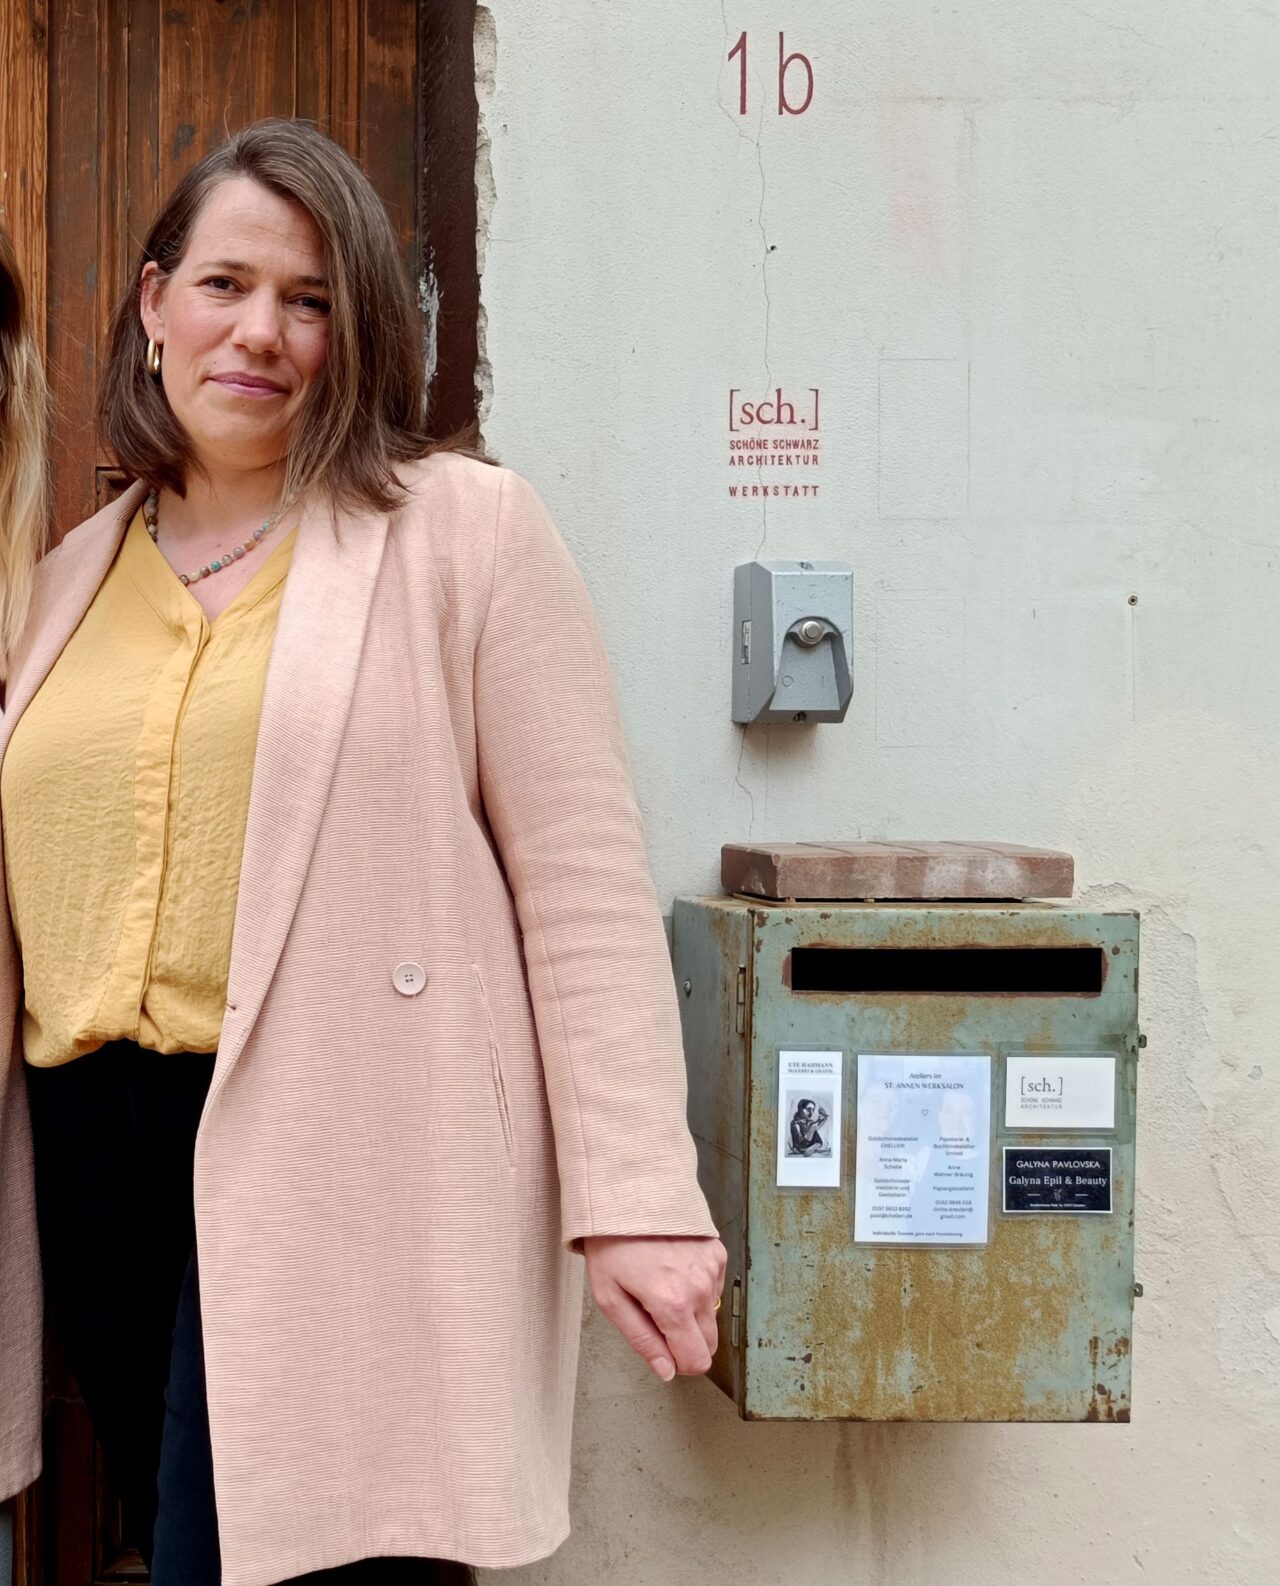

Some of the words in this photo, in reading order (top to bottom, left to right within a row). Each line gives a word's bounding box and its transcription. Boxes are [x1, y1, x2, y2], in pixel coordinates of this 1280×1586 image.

[729, 437, 769, 450] SCHÖNE
[772, 439, 820, 450] SCHWARZ
[729, 454, 819, 466] ARCHITEKTUR
[729, 485, 820, 497] WERKSTATT
[1016, 1160, 1050, 1168] GALYNA
[1052, 1160, 1101, 1168] PAVLOVSKA
[1009, 1176, 1041, 1187] Galyna
[1044, 1176, 1062, 1187] Epil
[1064, 1176, 1073, 1185] &
[1075, 1176, 1108, 1187] Beauty
